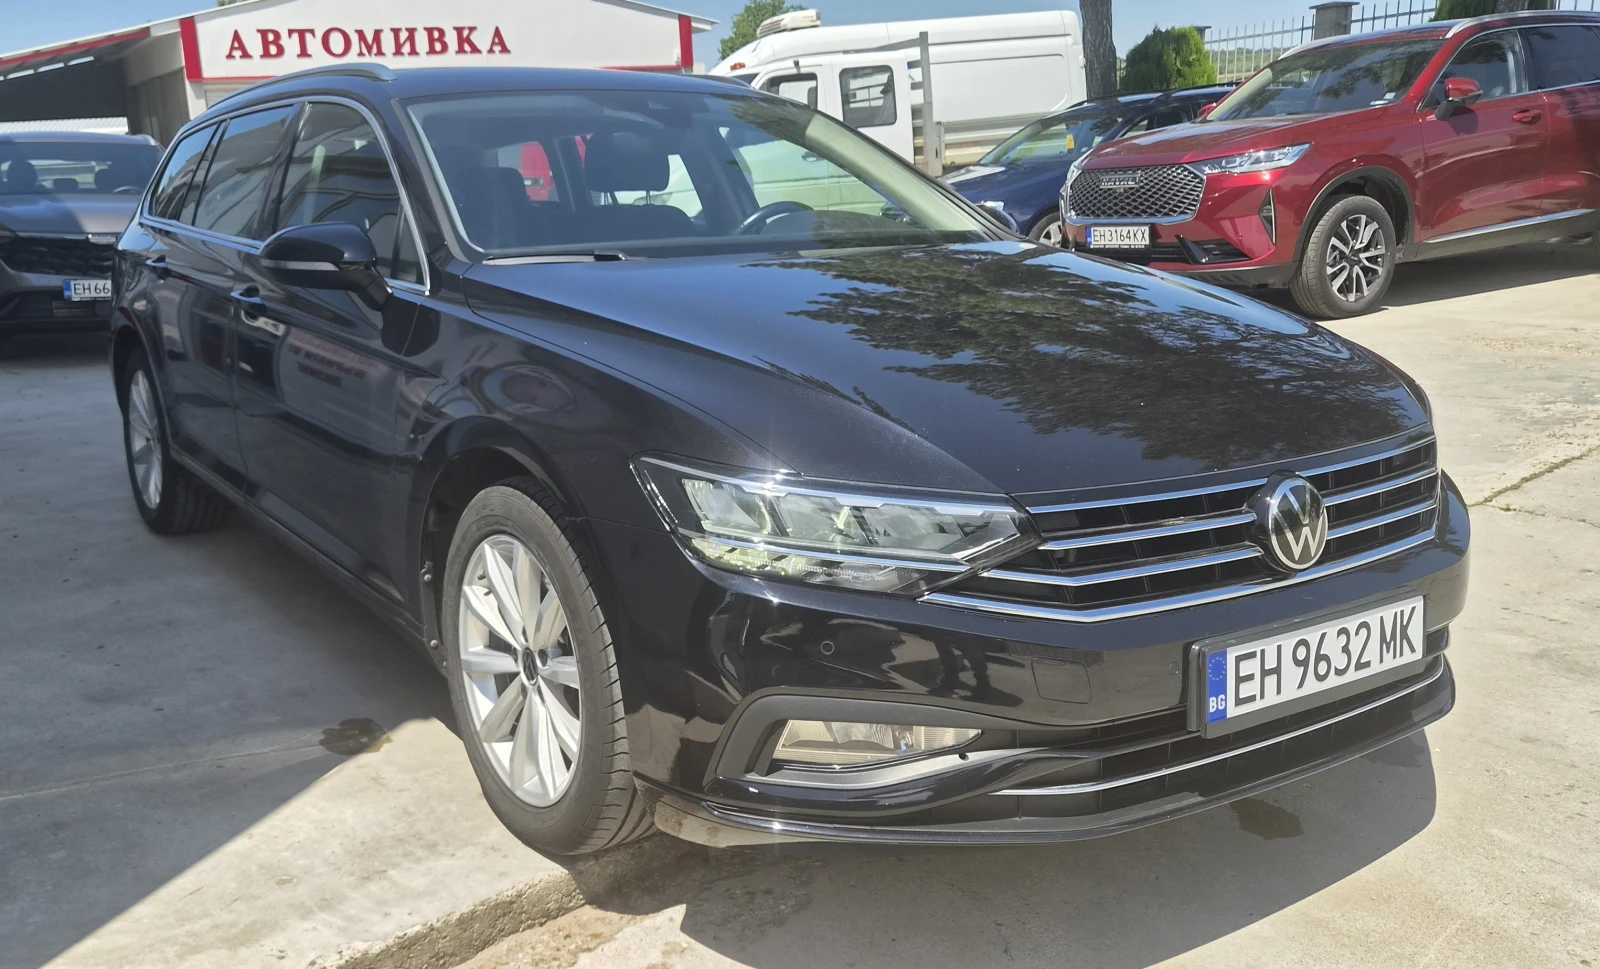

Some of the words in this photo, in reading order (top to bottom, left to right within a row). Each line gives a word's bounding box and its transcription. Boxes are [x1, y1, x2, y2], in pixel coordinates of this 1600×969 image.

[225, 26, 511, 60] АВТОМИВКА
[73, 282, 92, 295] EH
[1234, 644, 1282, 707] EH
[1292, 621, 1372, 692] 9632
[1379, 605, 1417, 664] MK
[1209, 694, 1226, 712] BG
